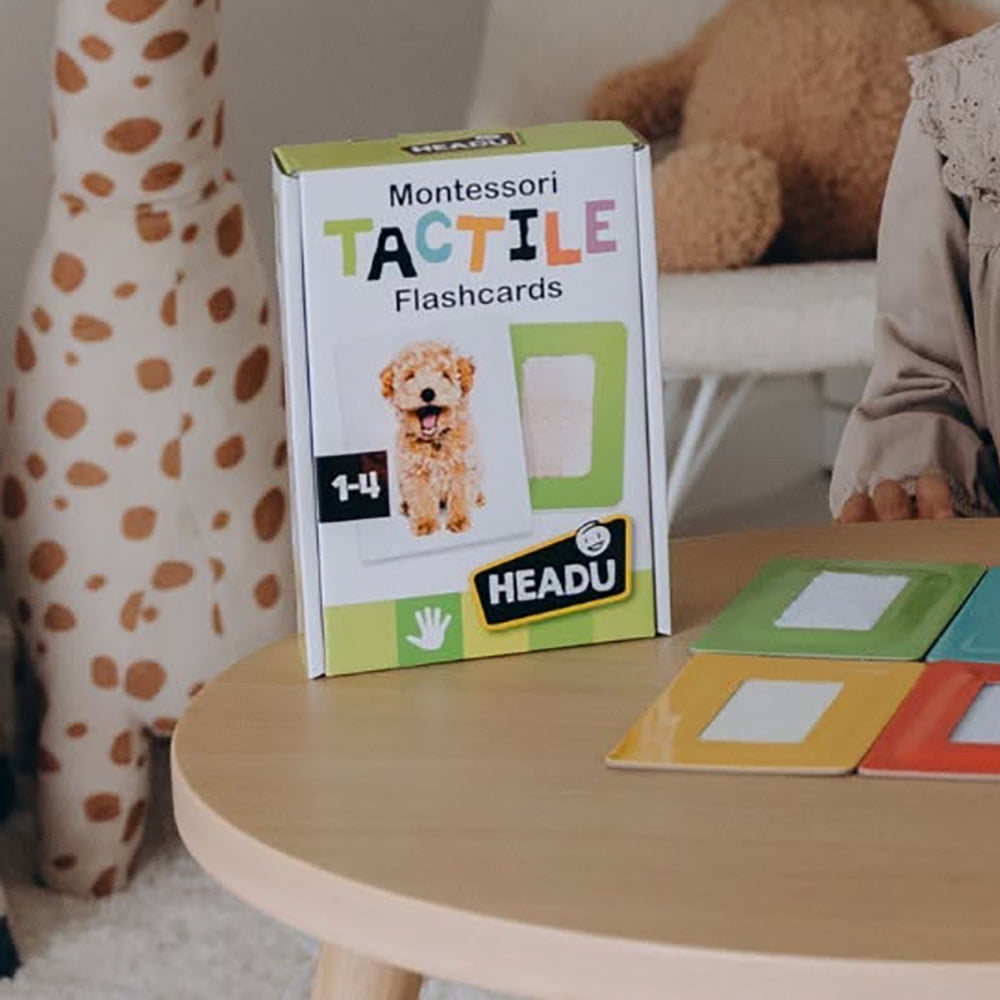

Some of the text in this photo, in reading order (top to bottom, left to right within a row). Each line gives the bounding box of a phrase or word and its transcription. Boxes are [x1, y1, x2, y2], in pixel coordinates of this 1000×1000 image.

[389, 171, 558, 207] Montessori
[323, 200, 617, 281] TACTILE
[395, 277, 563, 312] Flashcards
[331, 471, 381, 501] 1-4
[488, 559, 616, 604] HEADU
